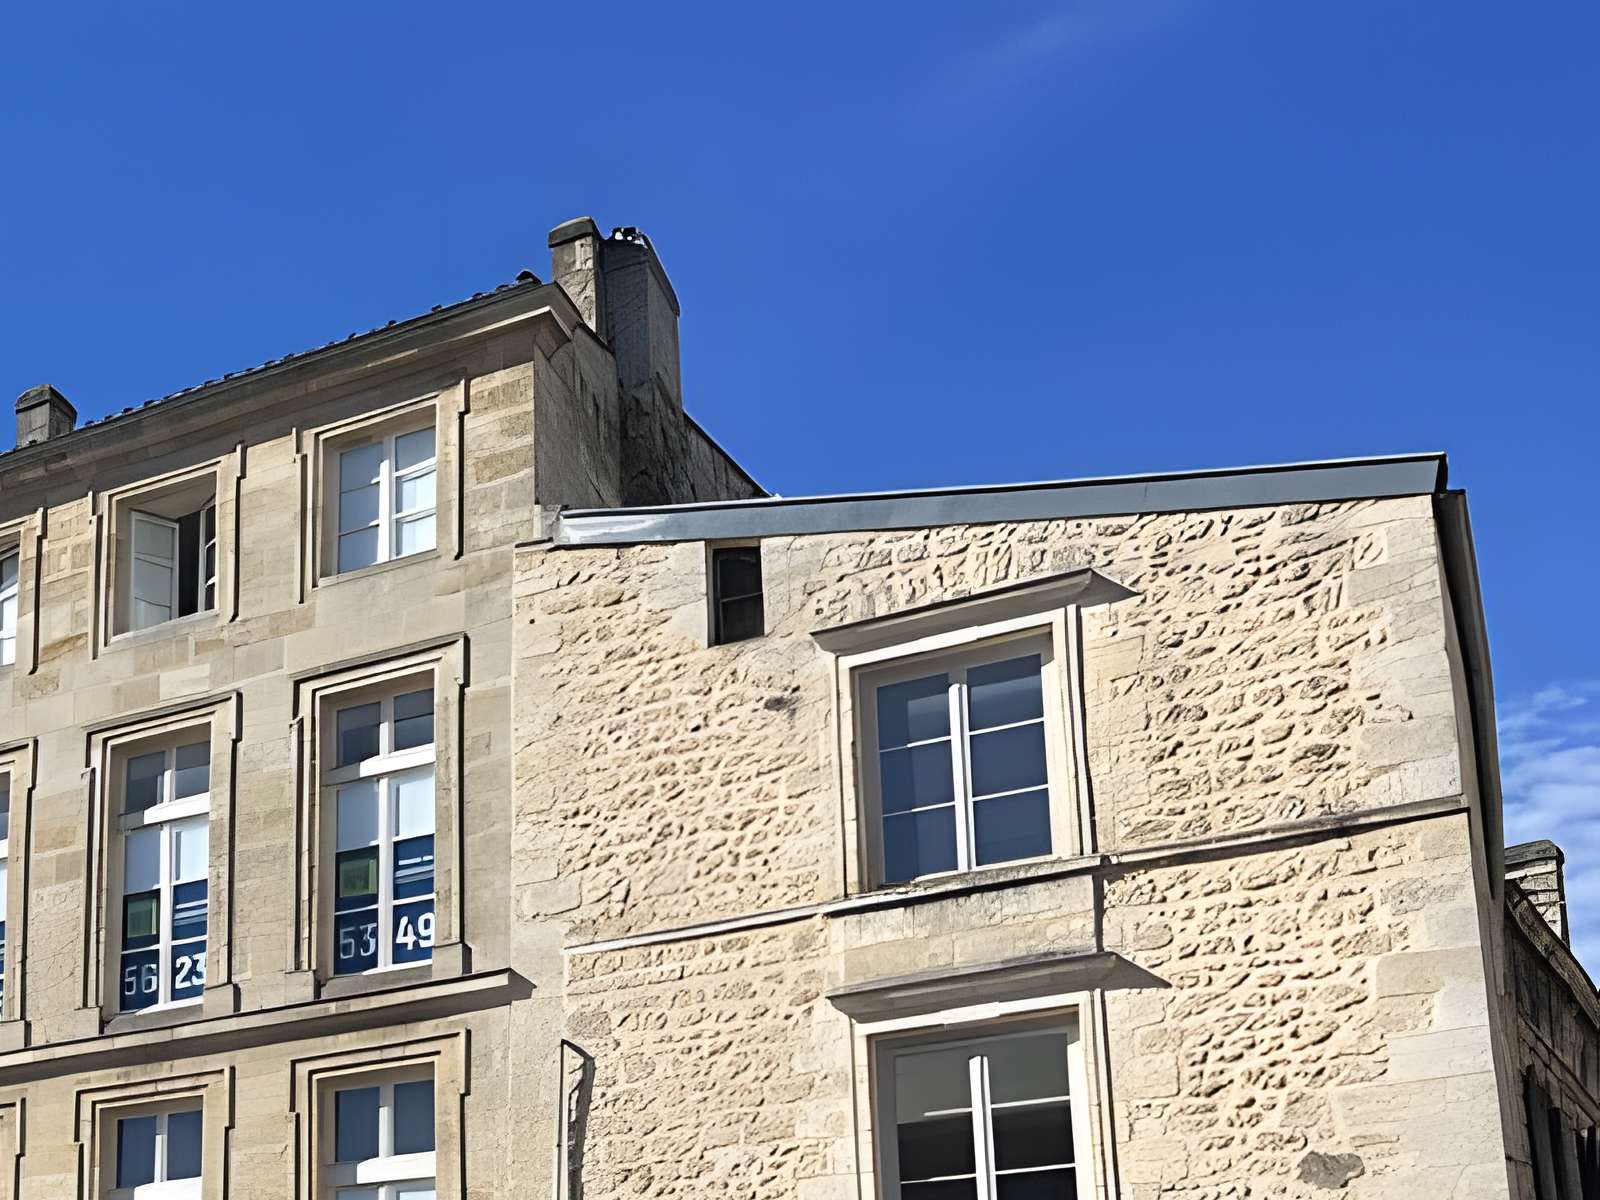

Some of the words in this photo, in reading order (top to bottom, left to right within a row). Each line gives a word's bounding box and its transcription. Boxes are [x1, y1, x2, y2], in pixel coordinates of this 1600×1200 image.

[124, 964, 158, 996] 56
[175, 952, 207, 990] 23
[396, 912, 436, 950] 49
